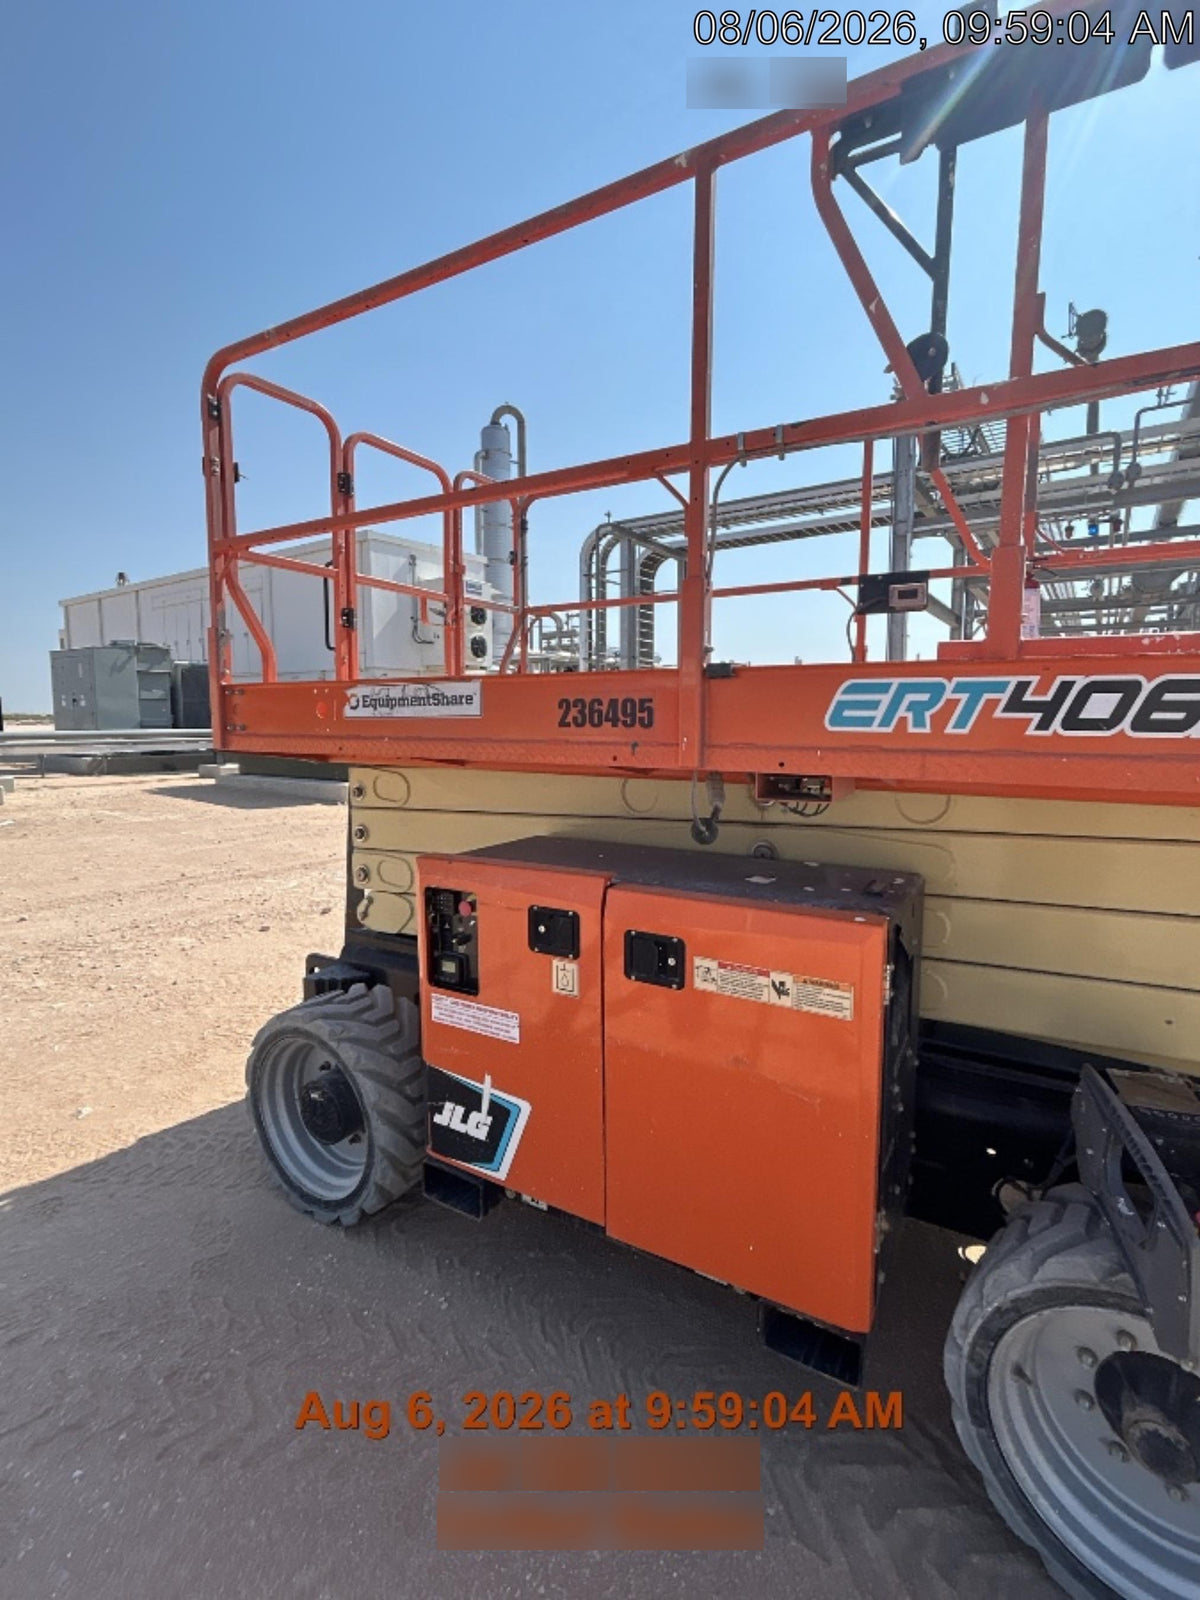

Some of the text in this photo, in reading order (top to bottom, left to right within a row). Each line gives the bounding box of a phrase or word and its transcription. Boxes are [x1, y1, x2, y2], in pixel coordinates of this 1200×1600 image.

[361, 692, 475, 710] EquipmentShare
[557, 697, 655, 728] 236495
[433, 1101, 493, 1141] JLG
